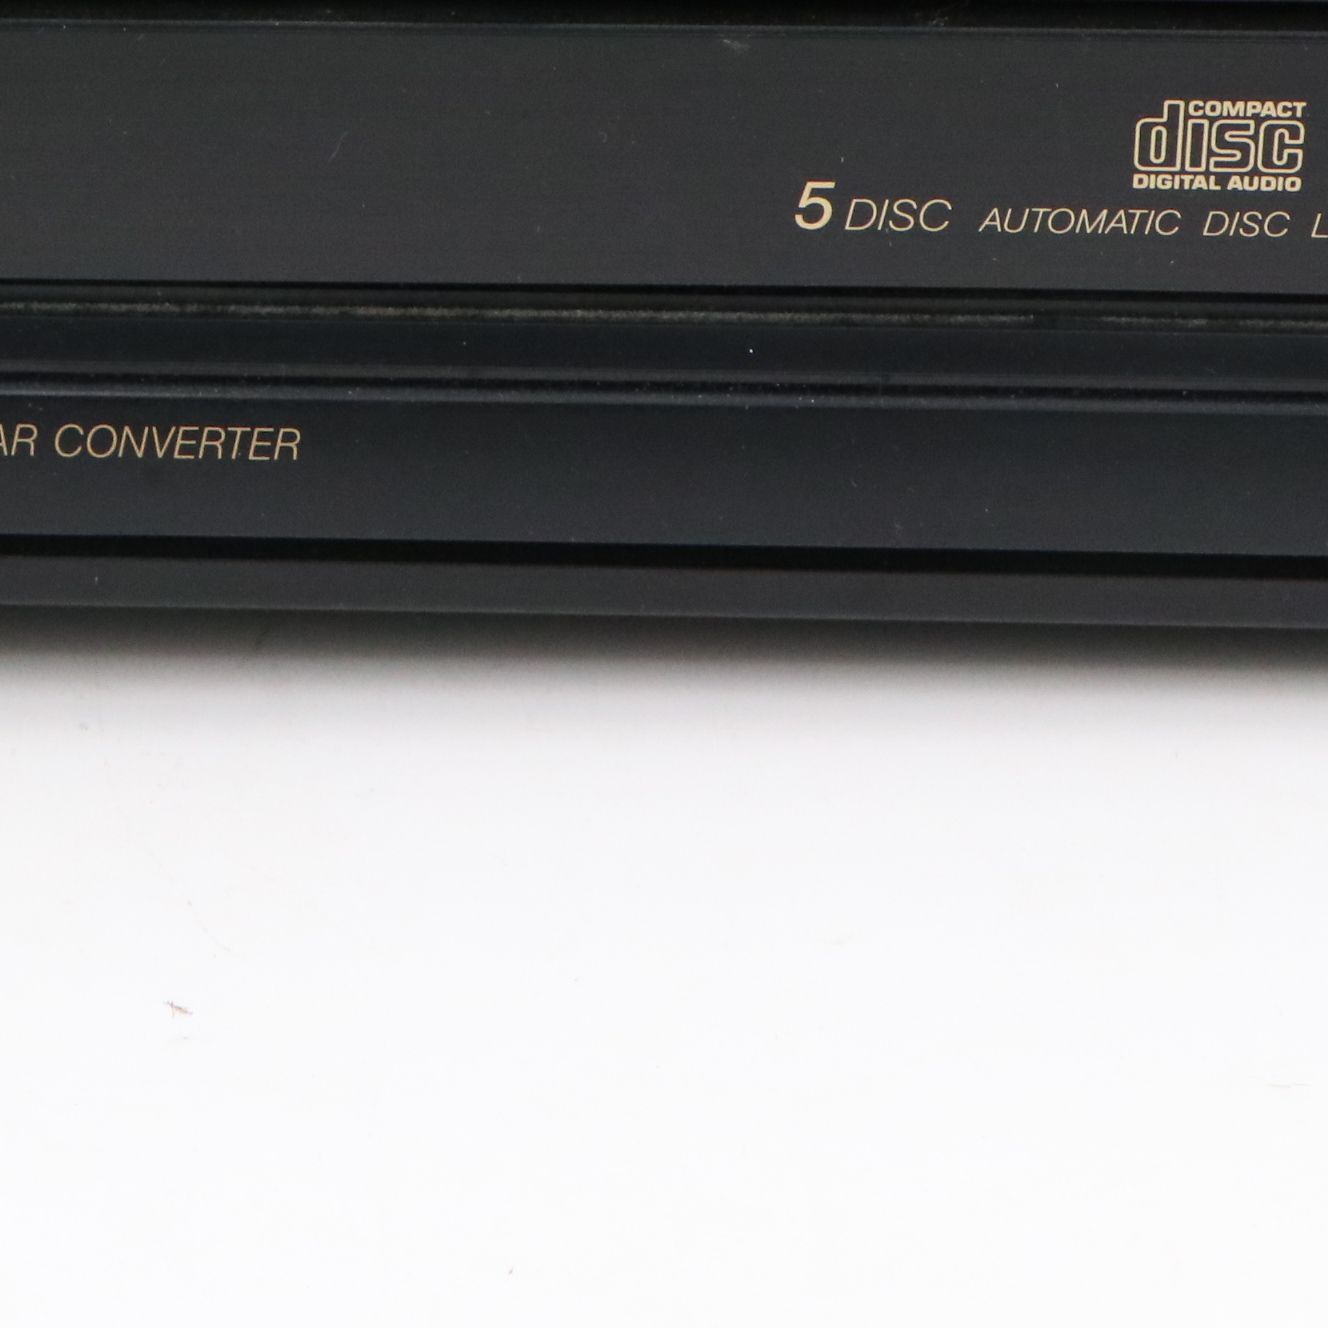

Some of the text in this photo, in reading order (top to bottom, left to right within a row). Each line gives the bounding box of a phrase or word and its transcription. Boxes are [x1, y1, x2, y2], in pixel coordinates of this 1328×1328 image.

[1188, 100, 1307, 118] COMPACT
[1132, 173, 1302, 192] DIGITAL AUDIO
[794, 181, 836, 231] 5
[844, 198, 953, 232] DISC
[978, 207, 1182, 236] AUTOMATIC
[1202, 210, 1291, 238] DISC
[54, 424, 301, 462] CONVERTER
